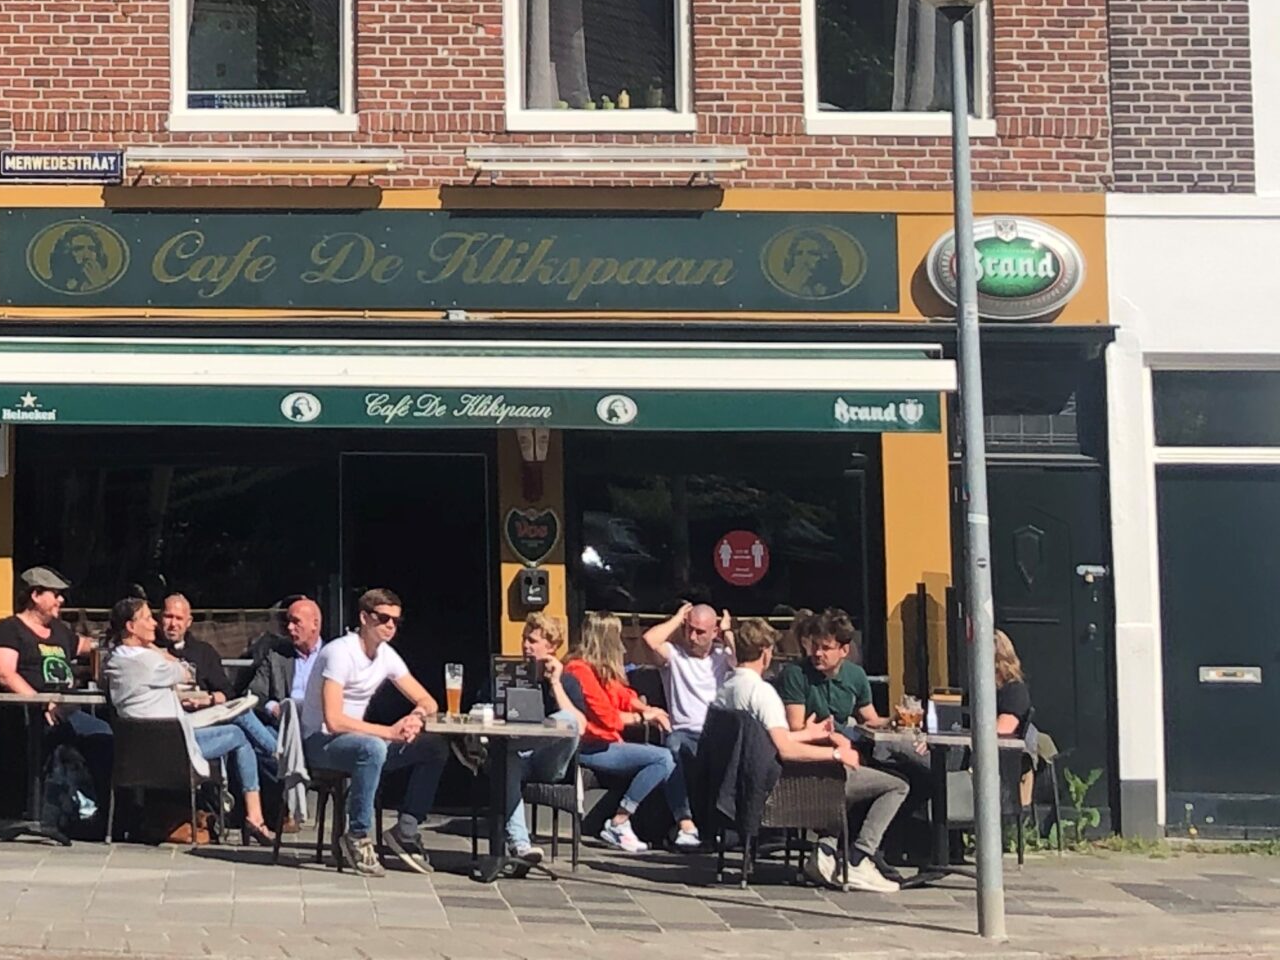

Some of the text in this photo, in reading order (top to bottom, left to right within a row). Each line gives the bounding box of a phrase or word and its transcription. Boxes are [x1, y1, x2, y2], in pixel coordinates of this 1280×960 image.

[5, 155, 117, 171] MERWEDESTRAAT
[151, 230, 738, 301] Cafe De Klikspaan
[2, 407, 57, 421] Heineken
[365, 393, 552, 424] Café De Klikspaan
[834, 397, 898, 424] Brand
